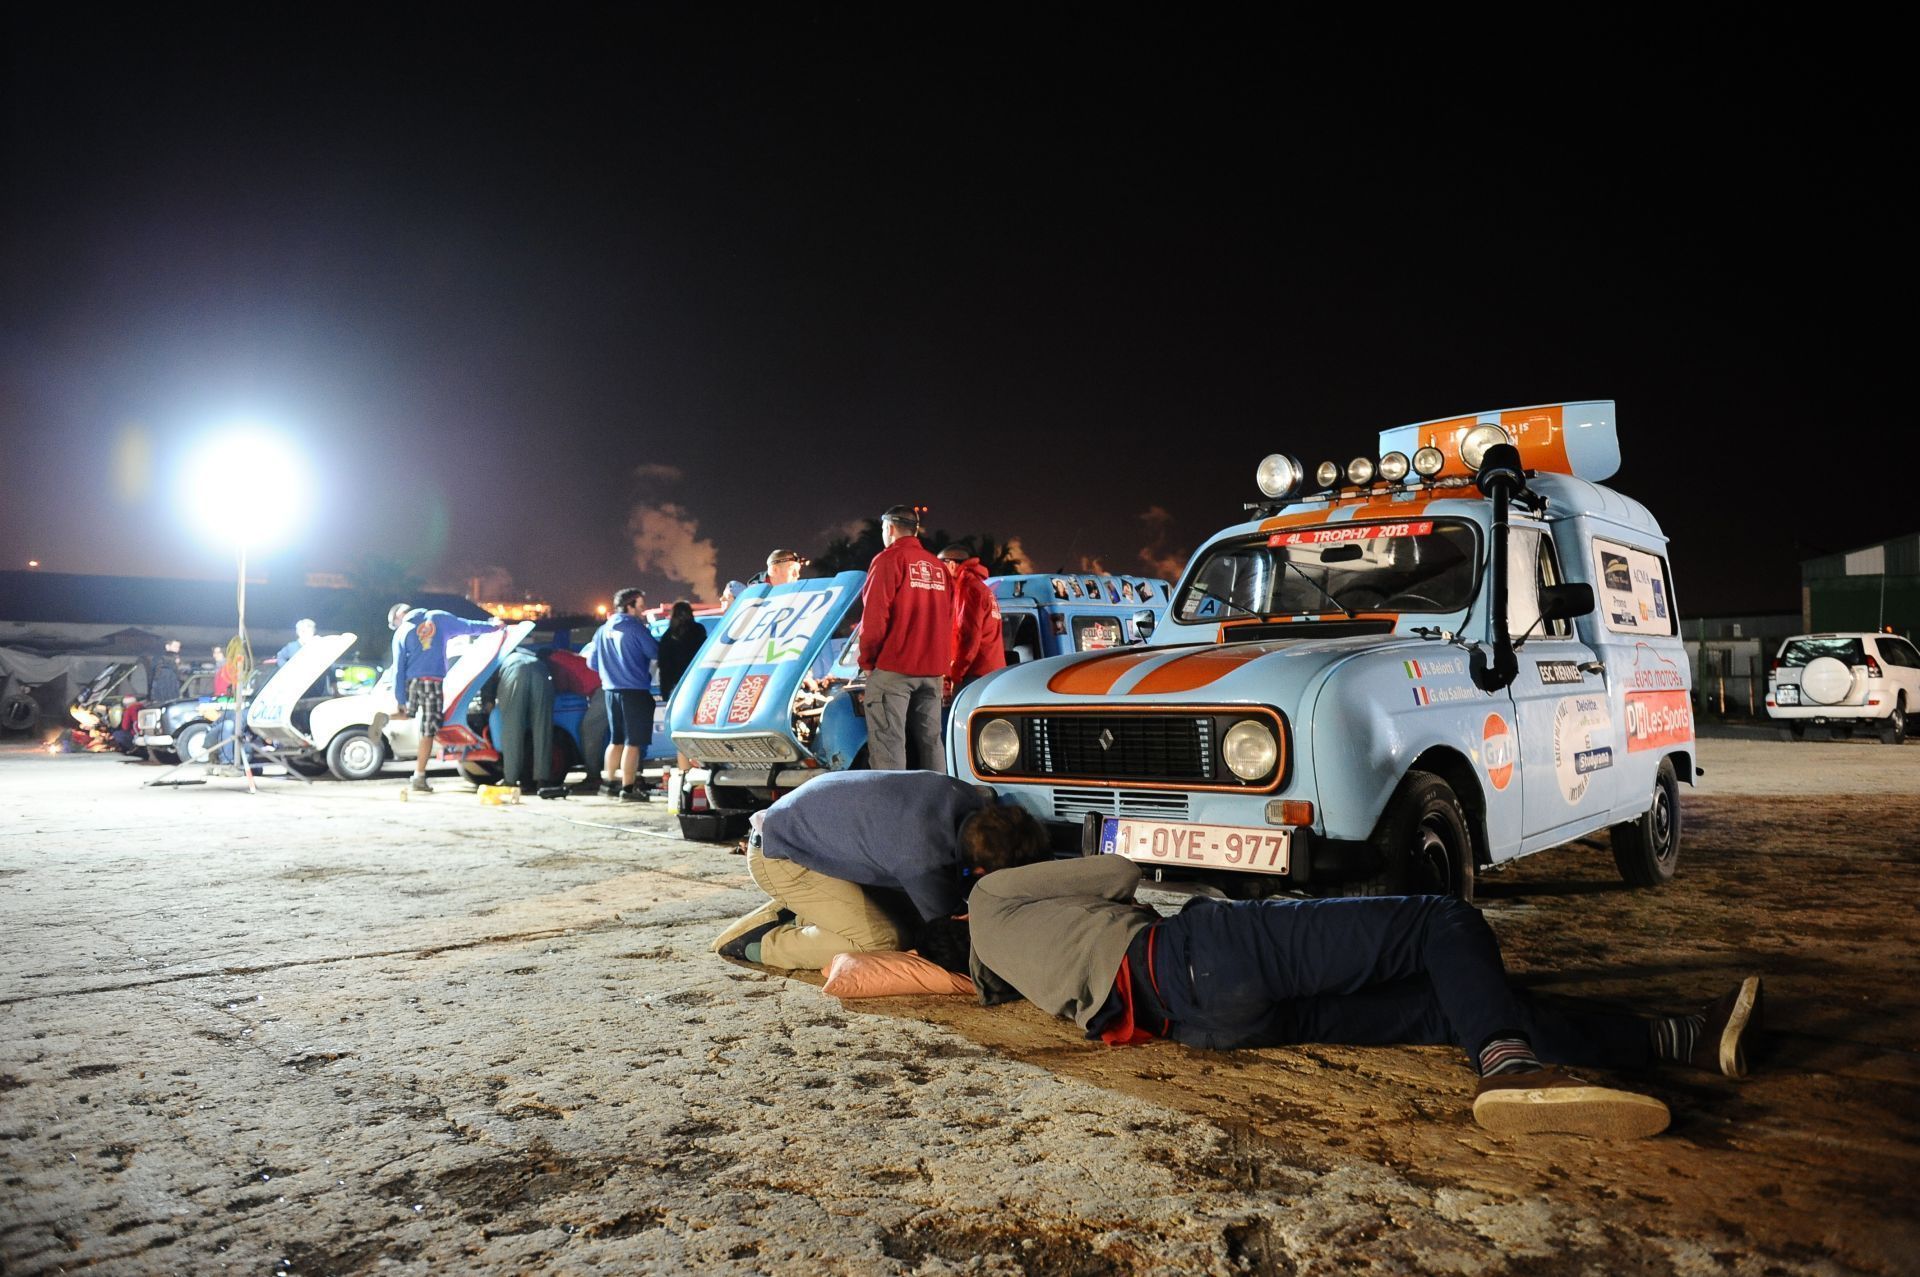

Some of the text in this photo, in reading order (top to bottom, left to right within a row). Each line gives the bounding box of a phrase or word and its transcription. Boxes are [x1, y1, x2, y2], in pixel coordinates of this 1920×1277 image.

[1287, 524, 1409, 544] 4L TROPHY 2013
[1200, 600, 1214, 614] A
[719, 590, 833, 645] CERP
[1539, 665, 1582, 681] ESC RENNES
[1635, 670, 1653, 687] EURO
[730, 678, 753, 720] FUNKY
[739, 676, 764, 721] BURGER
[1439, 689, 1448, 701] du
[1662, 704, 1689, 737] Sports
[1104, 841, 1114, 854] B
